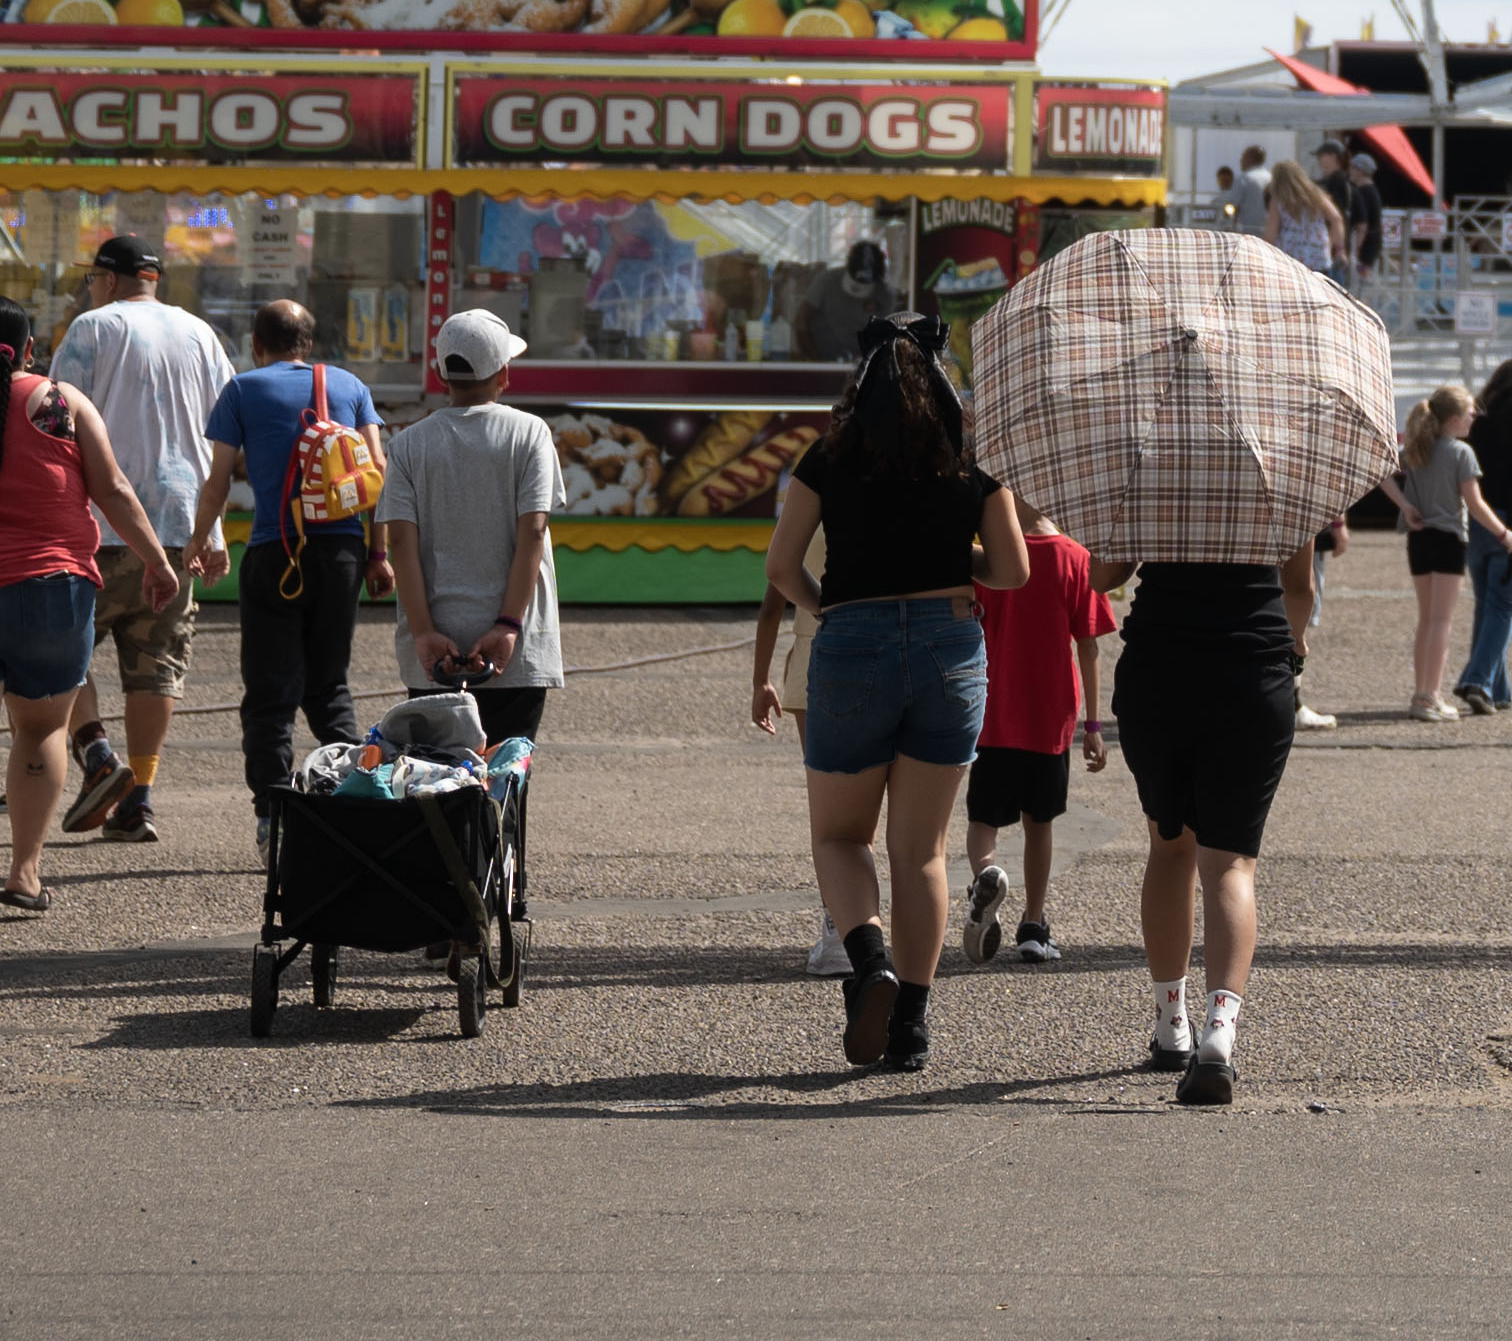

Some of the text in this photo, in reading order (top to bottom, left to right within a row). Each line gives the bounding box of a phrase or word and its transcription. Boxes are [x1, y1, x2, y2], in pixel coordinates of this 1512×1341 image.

[489, 92, 980, 156] CORN DOGS
[261, 214, 280, 225] NO
[251, 231, 289, 243] CASH
[1167, 988, 1180, 1003] M
[1213, 994, 1227, 1009] M
